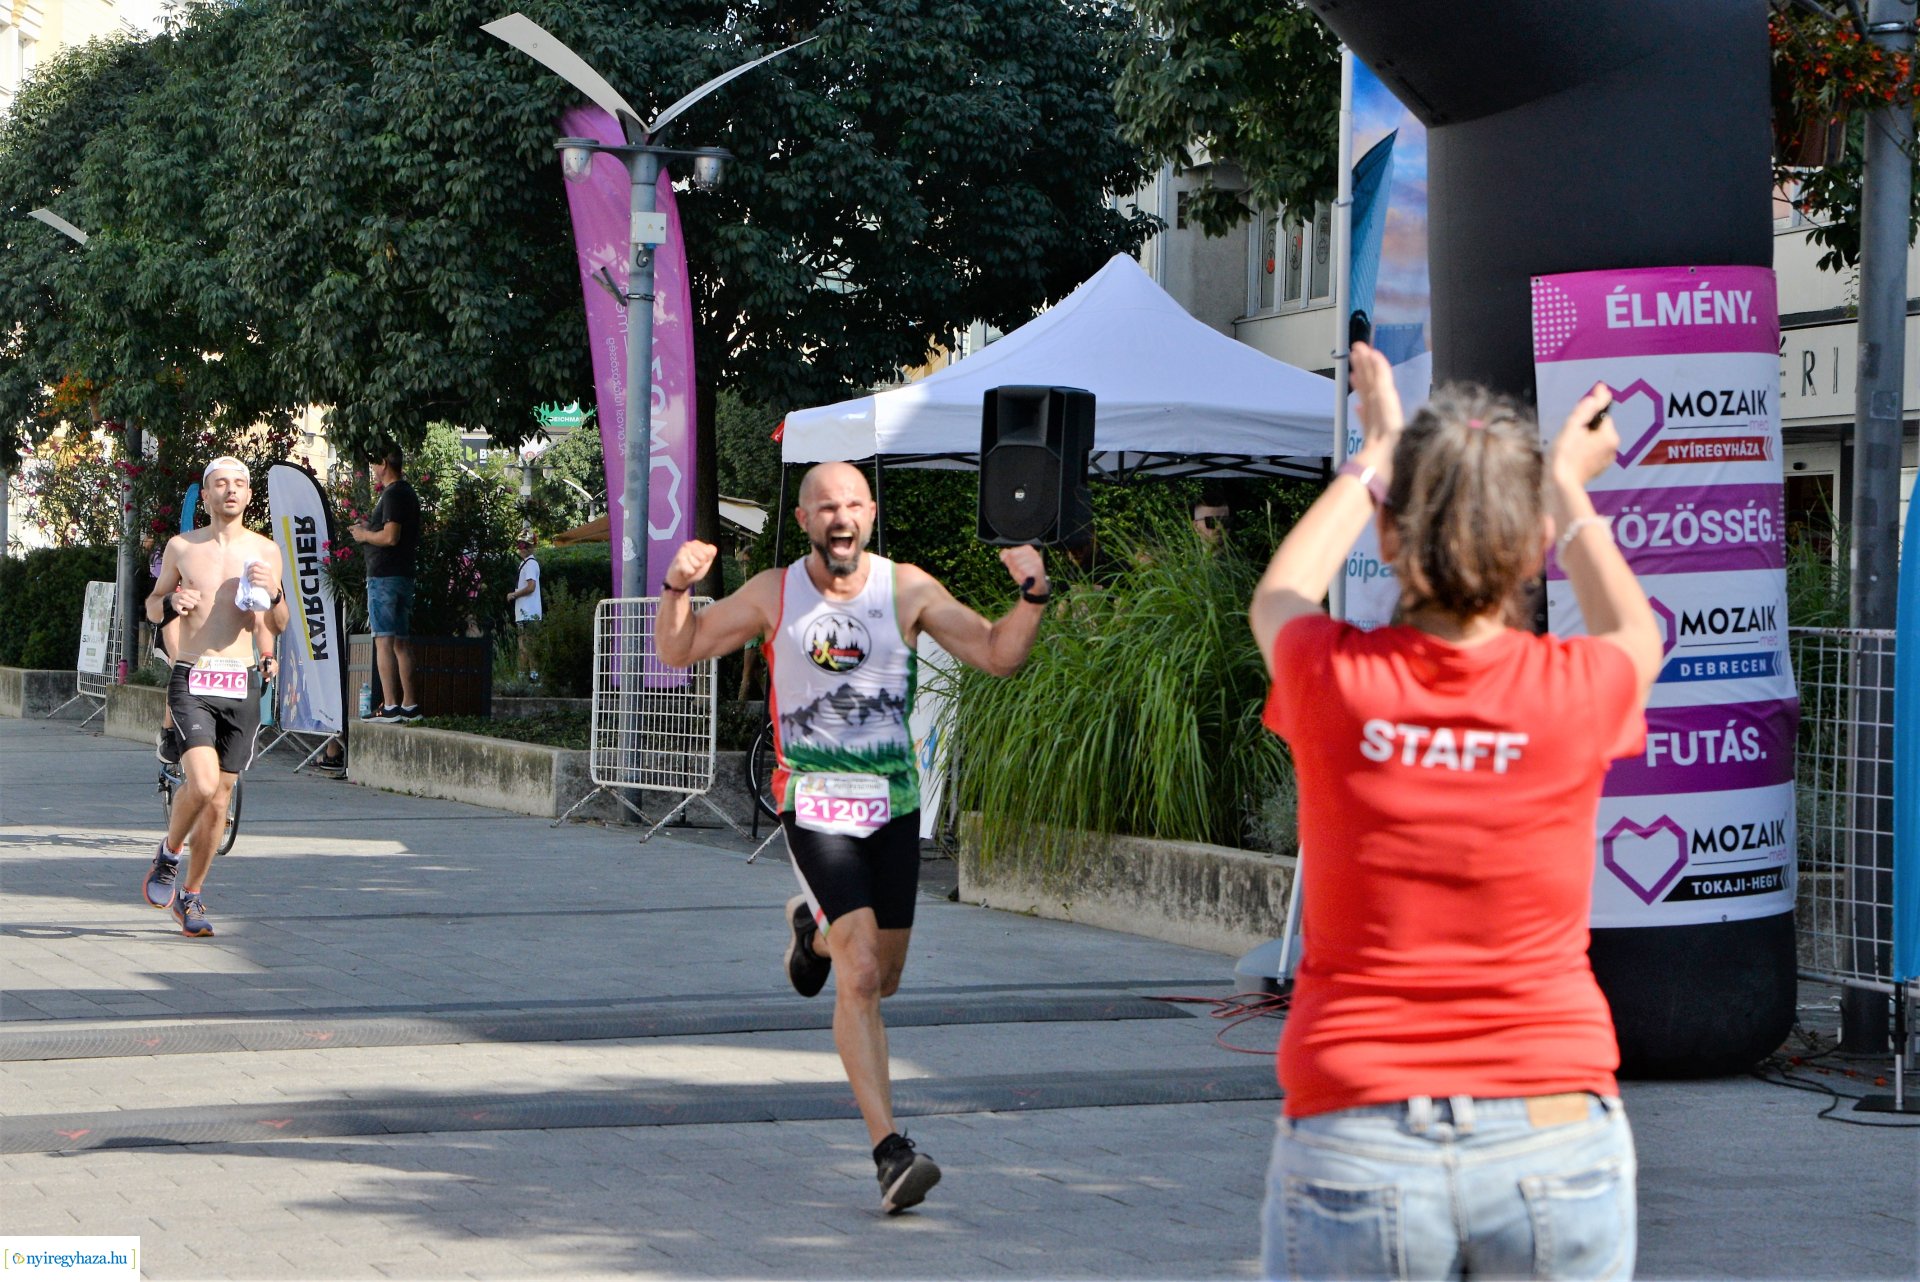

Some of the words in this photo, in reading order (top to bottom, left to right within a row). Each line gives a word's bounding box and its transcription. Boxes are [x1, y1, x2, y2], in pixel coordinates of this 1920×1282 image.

[1606, 282, 1757, 329] ÉLMÉNY.
[1668, 390, 1768, 418] MOZAIK
[1668, 440, 1760, 459] NYÍREGYHÁZA
[1607, 500, 1777, 549] ÖZÖSSÉG.
[1680, 605, 1777, 636] MOZAIK
[191, 672, 246, 689] 21216
[1680, 659, 1767, 677] DEBRECEN
[1359, 718, 1530, 775] STAFF
[1646, 719, 1768, 768] FUTÁS.
[799, 797, 887, 823] 21202
[1691, 819, 1786, 854] MOZAIK
[1691, 873, 1779, 896] TOKAJI-HEGY
